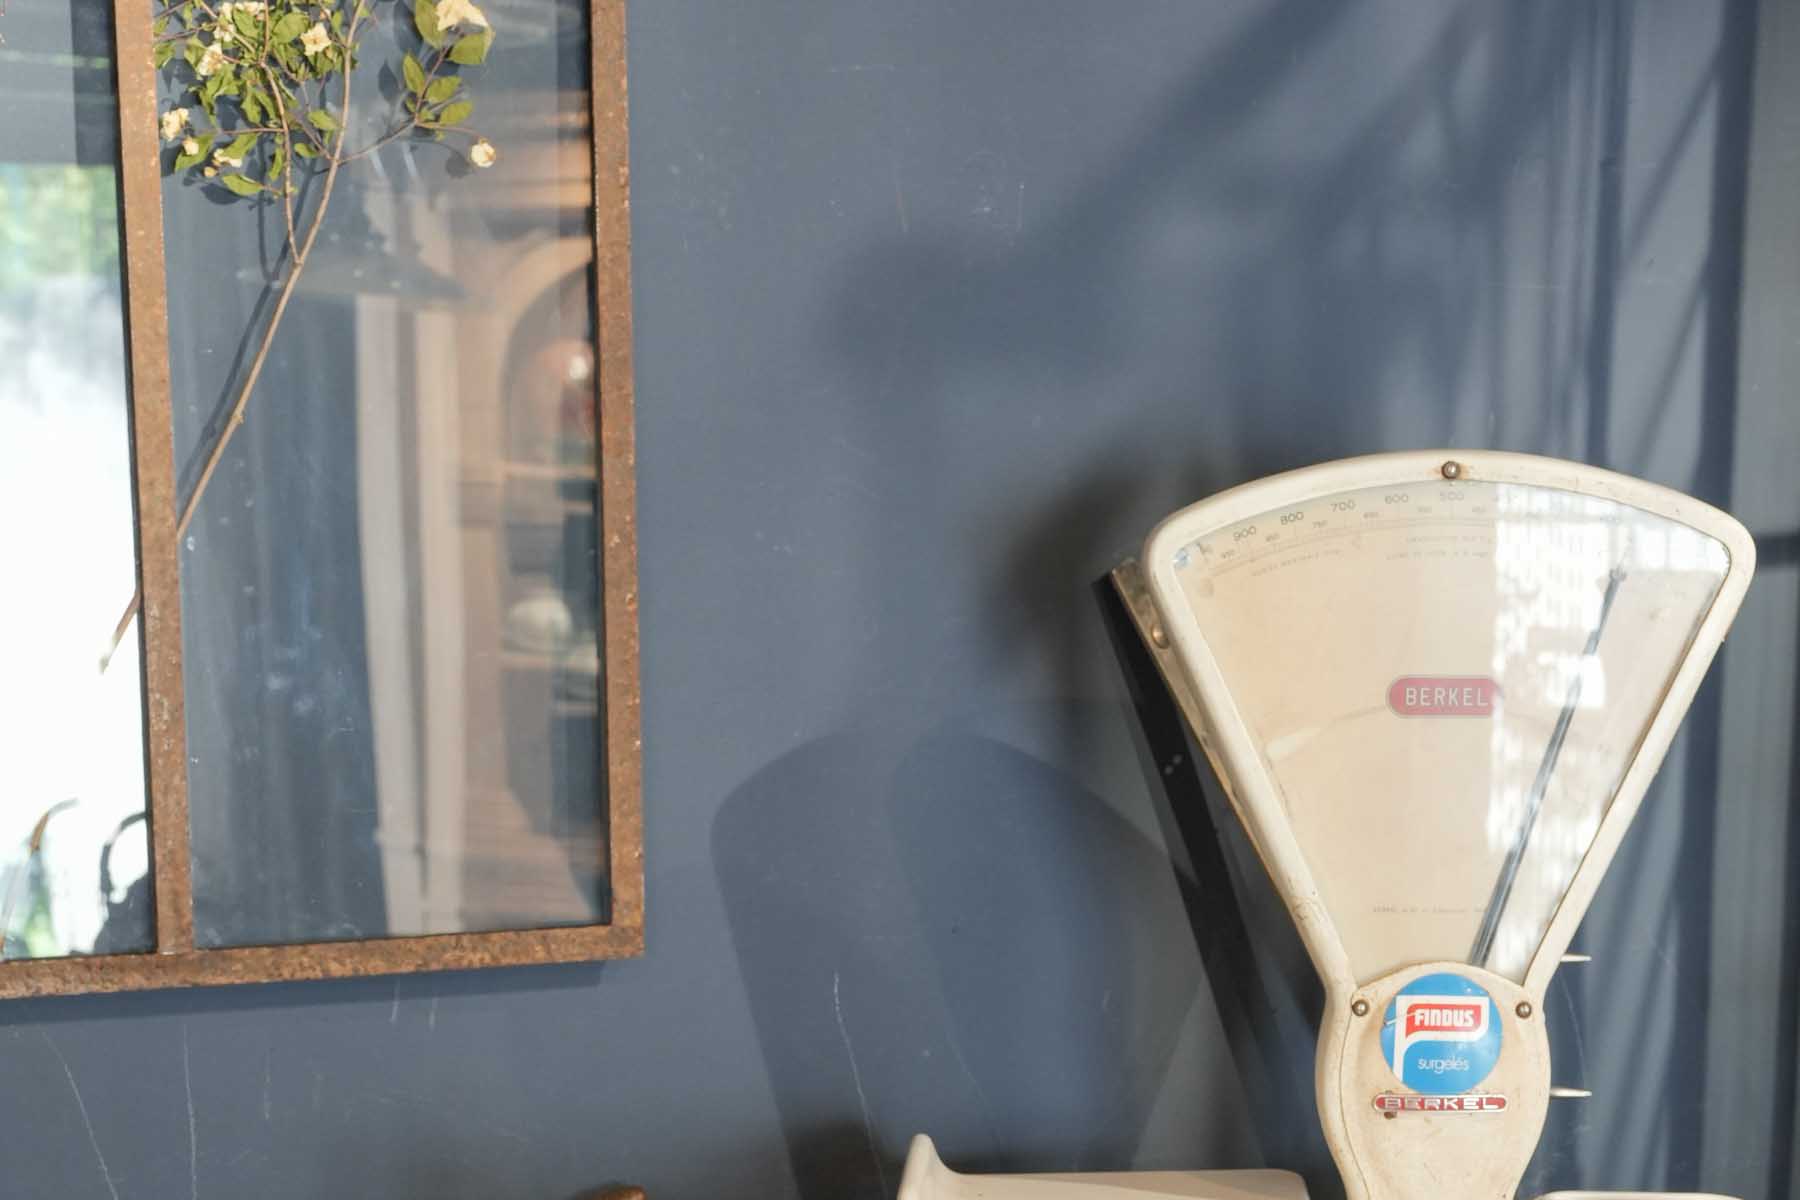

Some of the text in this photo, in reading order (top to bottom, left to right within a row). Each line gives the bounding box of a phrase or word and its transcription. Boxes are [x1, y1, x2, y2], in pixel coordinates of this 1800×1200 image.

[1233, 526, 1257, 542] 900
[1280, 511, 1304, 526] 800
[1330, 499, 1356, 513] 700
[1384, 493, 1409, 504] 600
[1405, 686, 1489, 707] BERKEL
[1414, 1008, 1475, 1027] FINDUS
[1384, 1096, 1499, 1111] BERKEL
